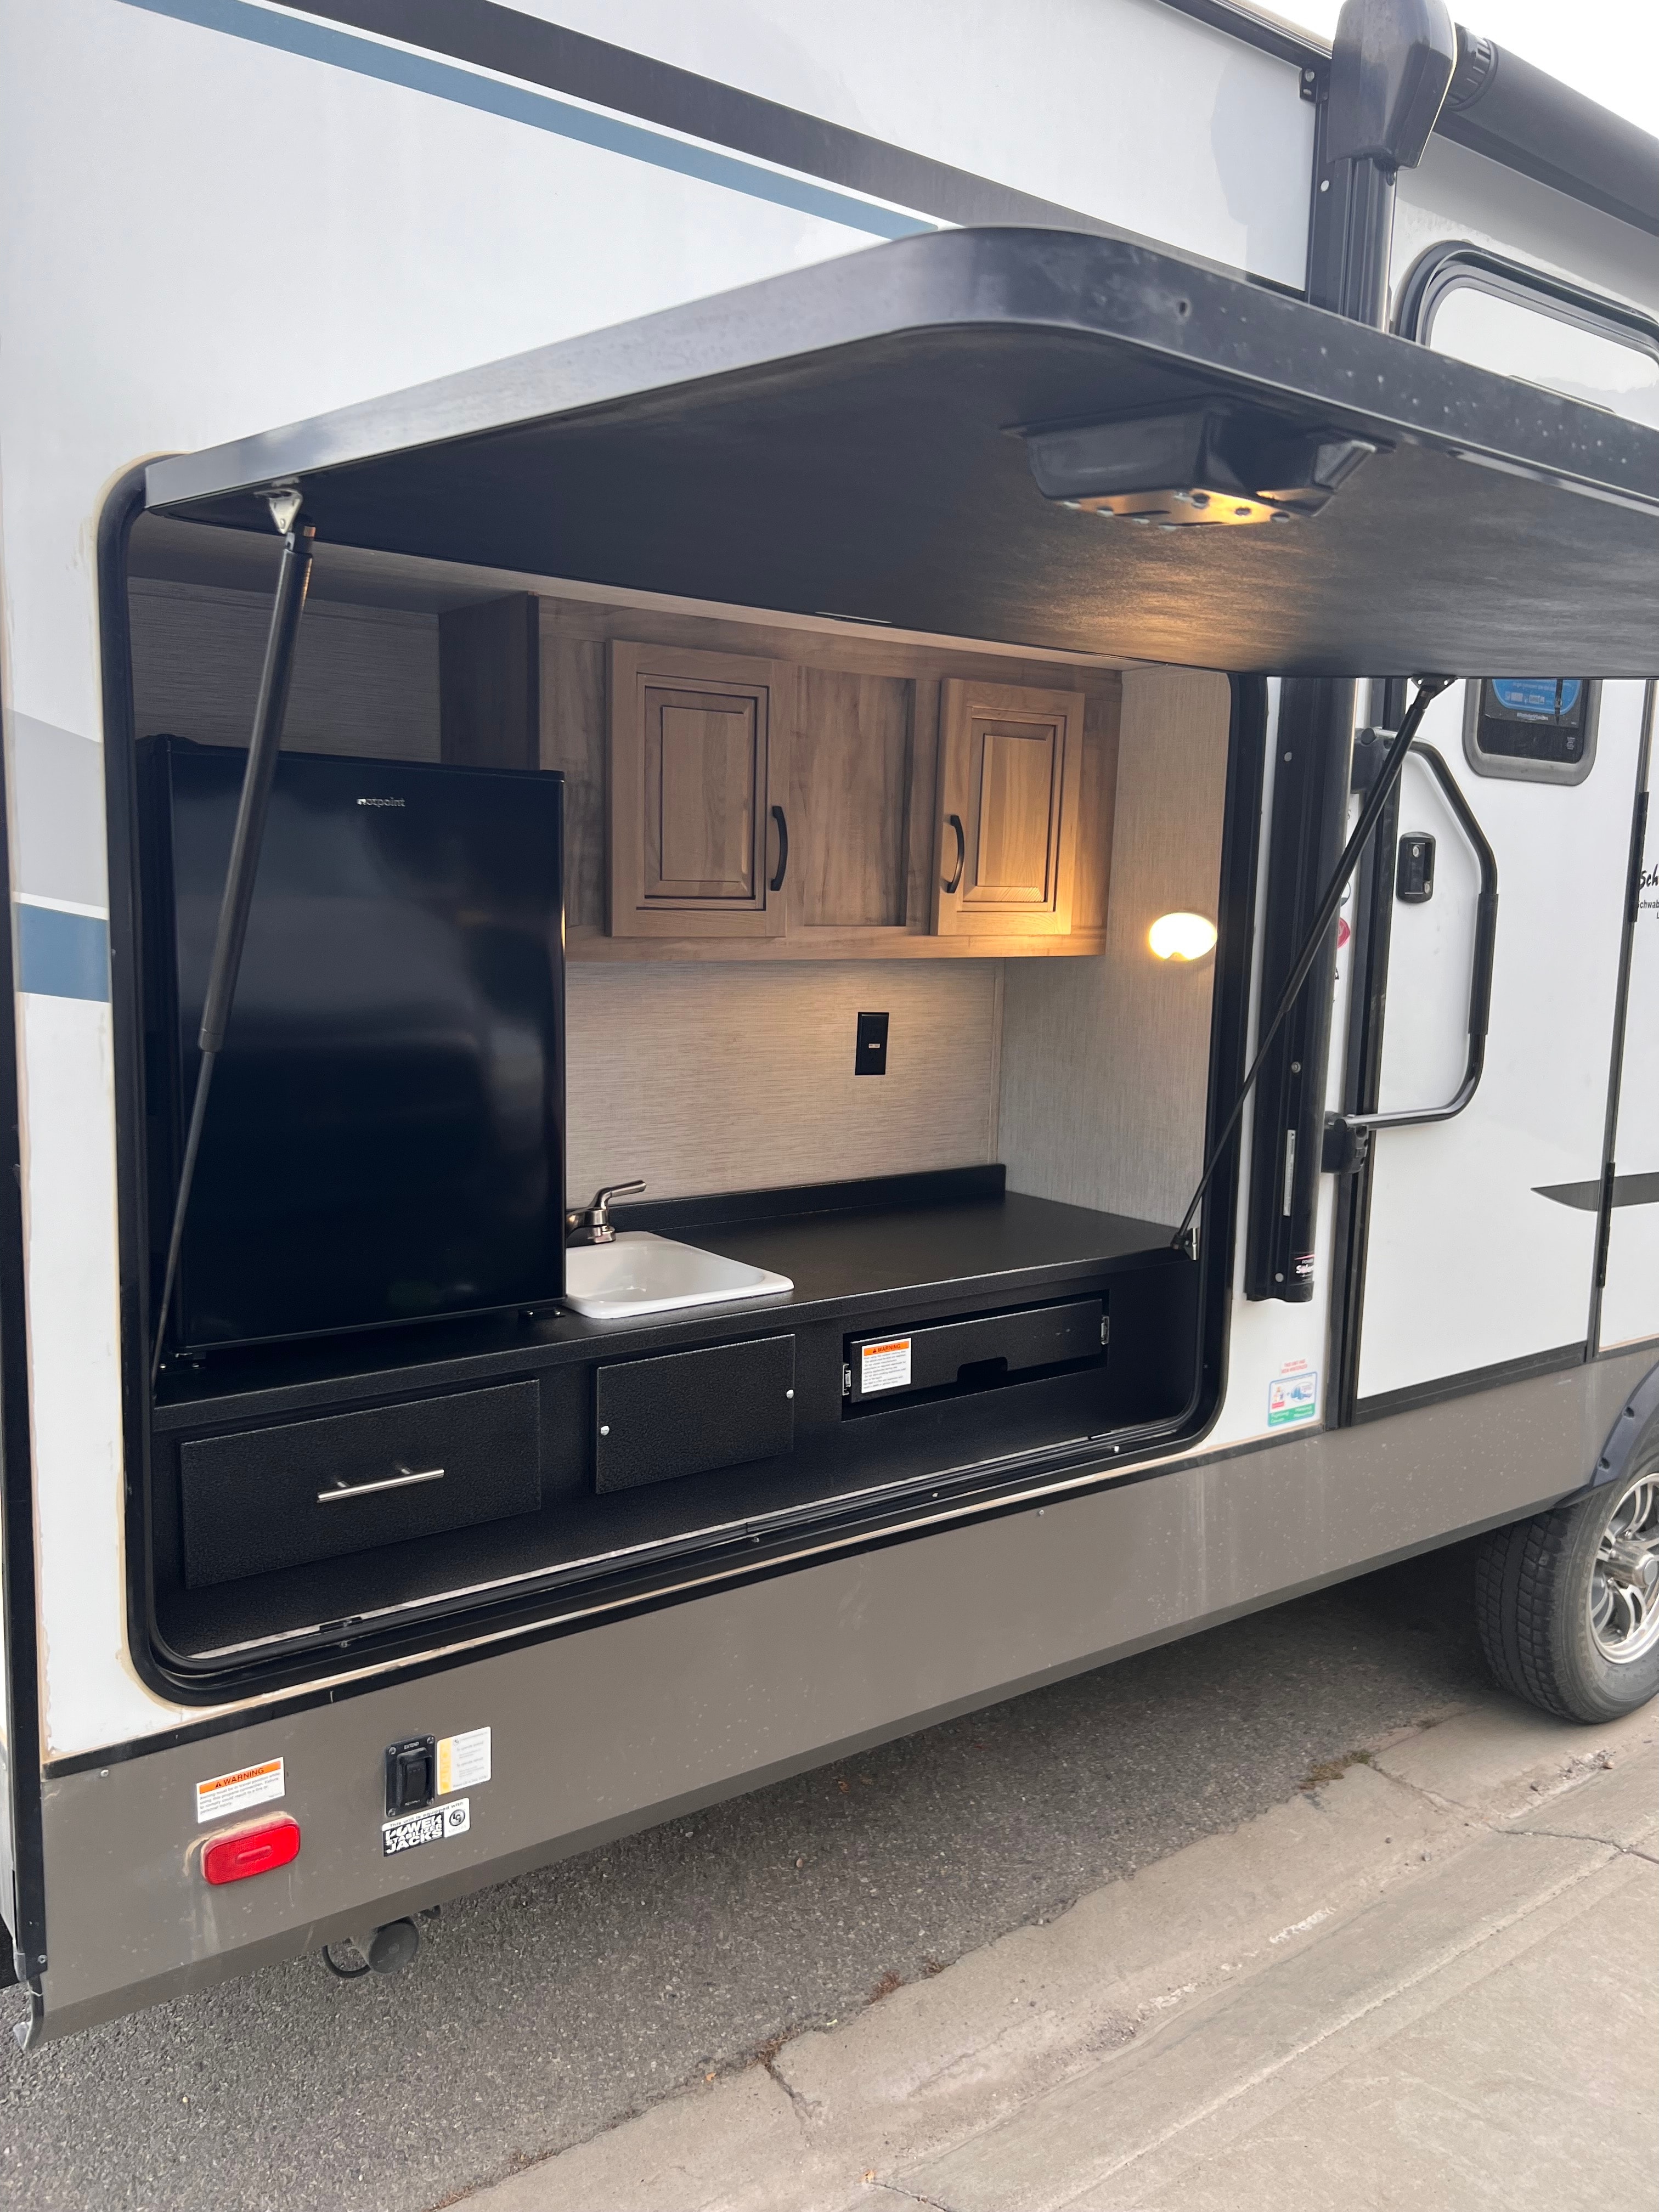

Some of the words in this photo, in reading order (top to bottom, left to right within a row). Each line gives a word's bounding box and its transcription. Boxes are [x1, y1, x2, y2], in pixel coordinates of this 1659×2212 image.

[1638, 900, 1659, 909] chwab
[404, 1741, 419, 1750] EXTEND
[223, 1767, 264, 1786] WARNING
[423, 1805, 449, 1818] equipped
[385, 1813, 442, 1841] POWER
[386, 1822, 442, 1846] STABILIZER
[386, 1827, 442, 1854] JACKS
